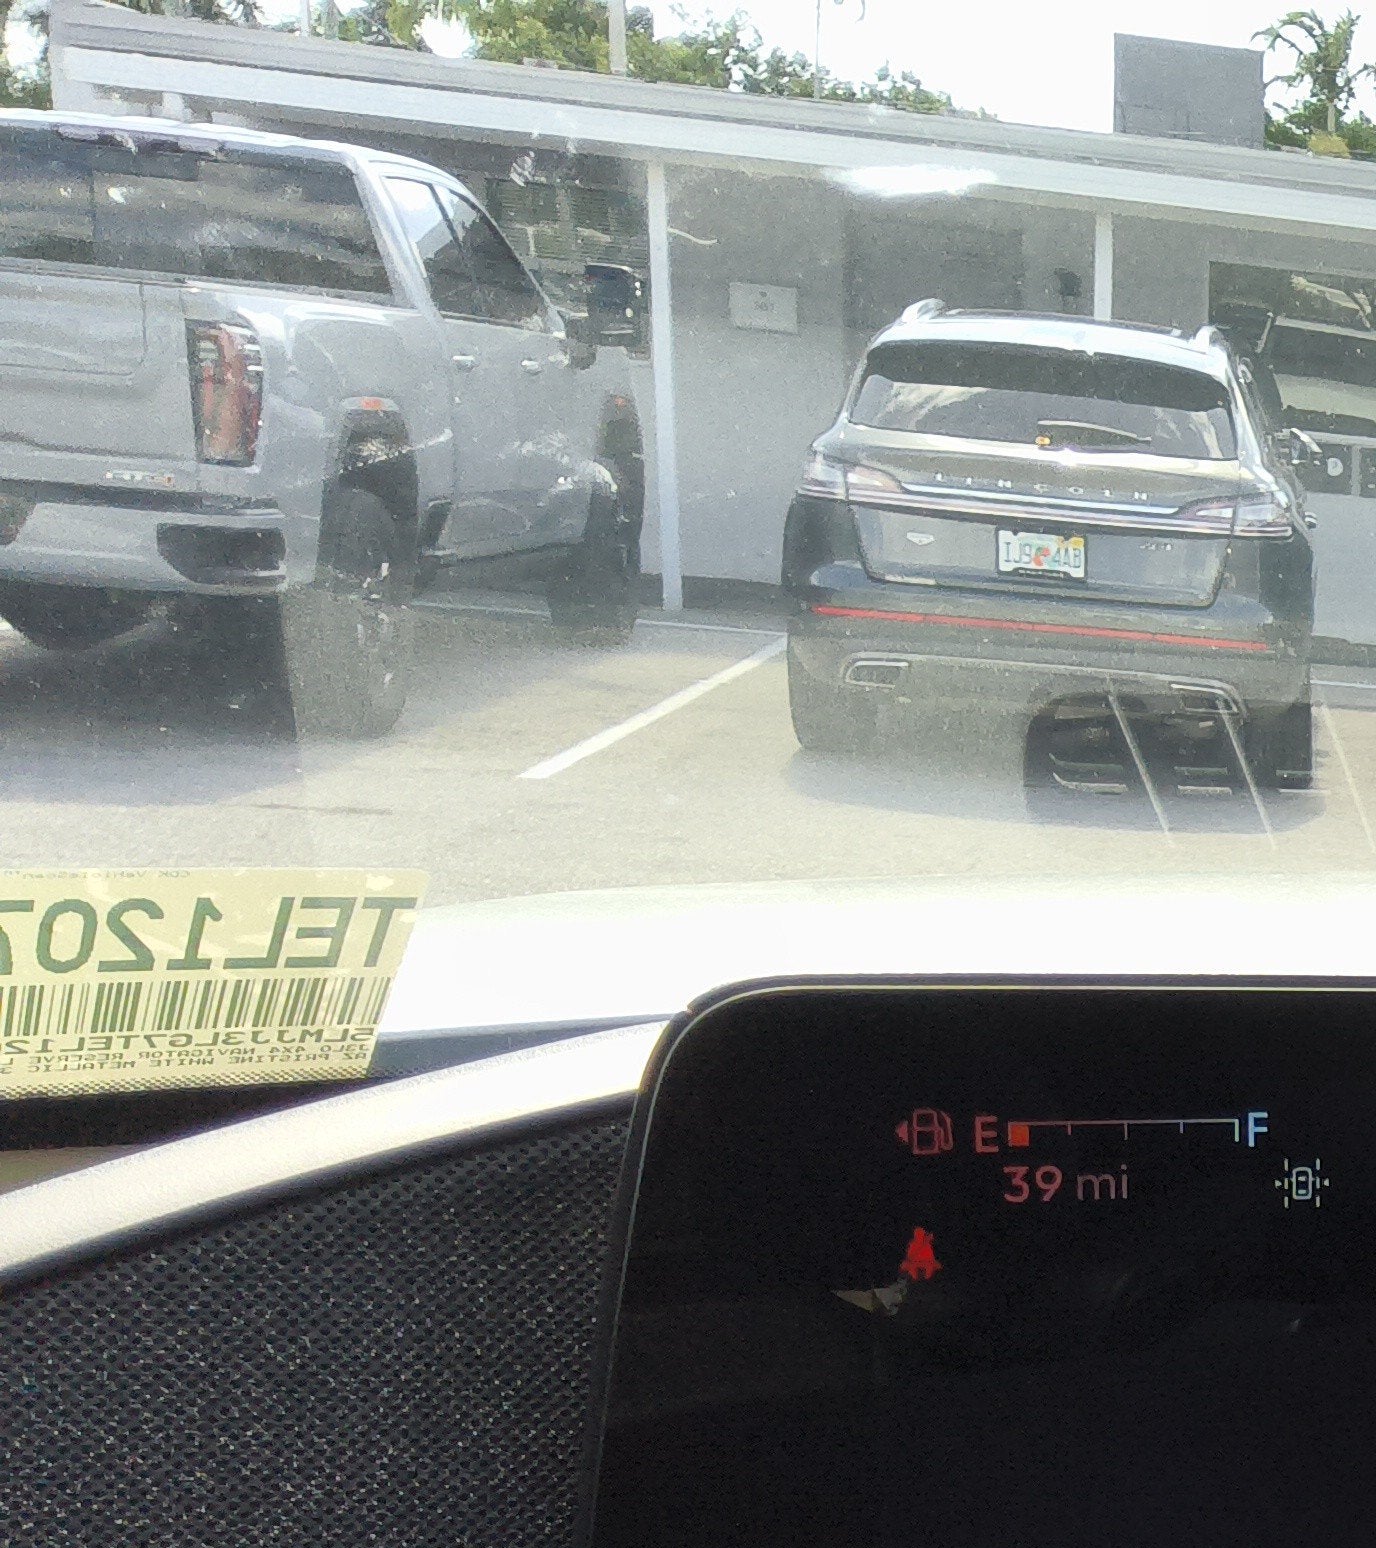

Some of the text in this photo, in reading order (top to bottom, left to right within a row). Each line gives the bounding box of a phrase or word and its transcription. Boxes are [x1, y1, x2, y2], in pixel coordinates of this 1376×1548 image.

[974, 1111, 1269, 1153] E F
[1002, 1164, 1130, 1204] 39 mi
